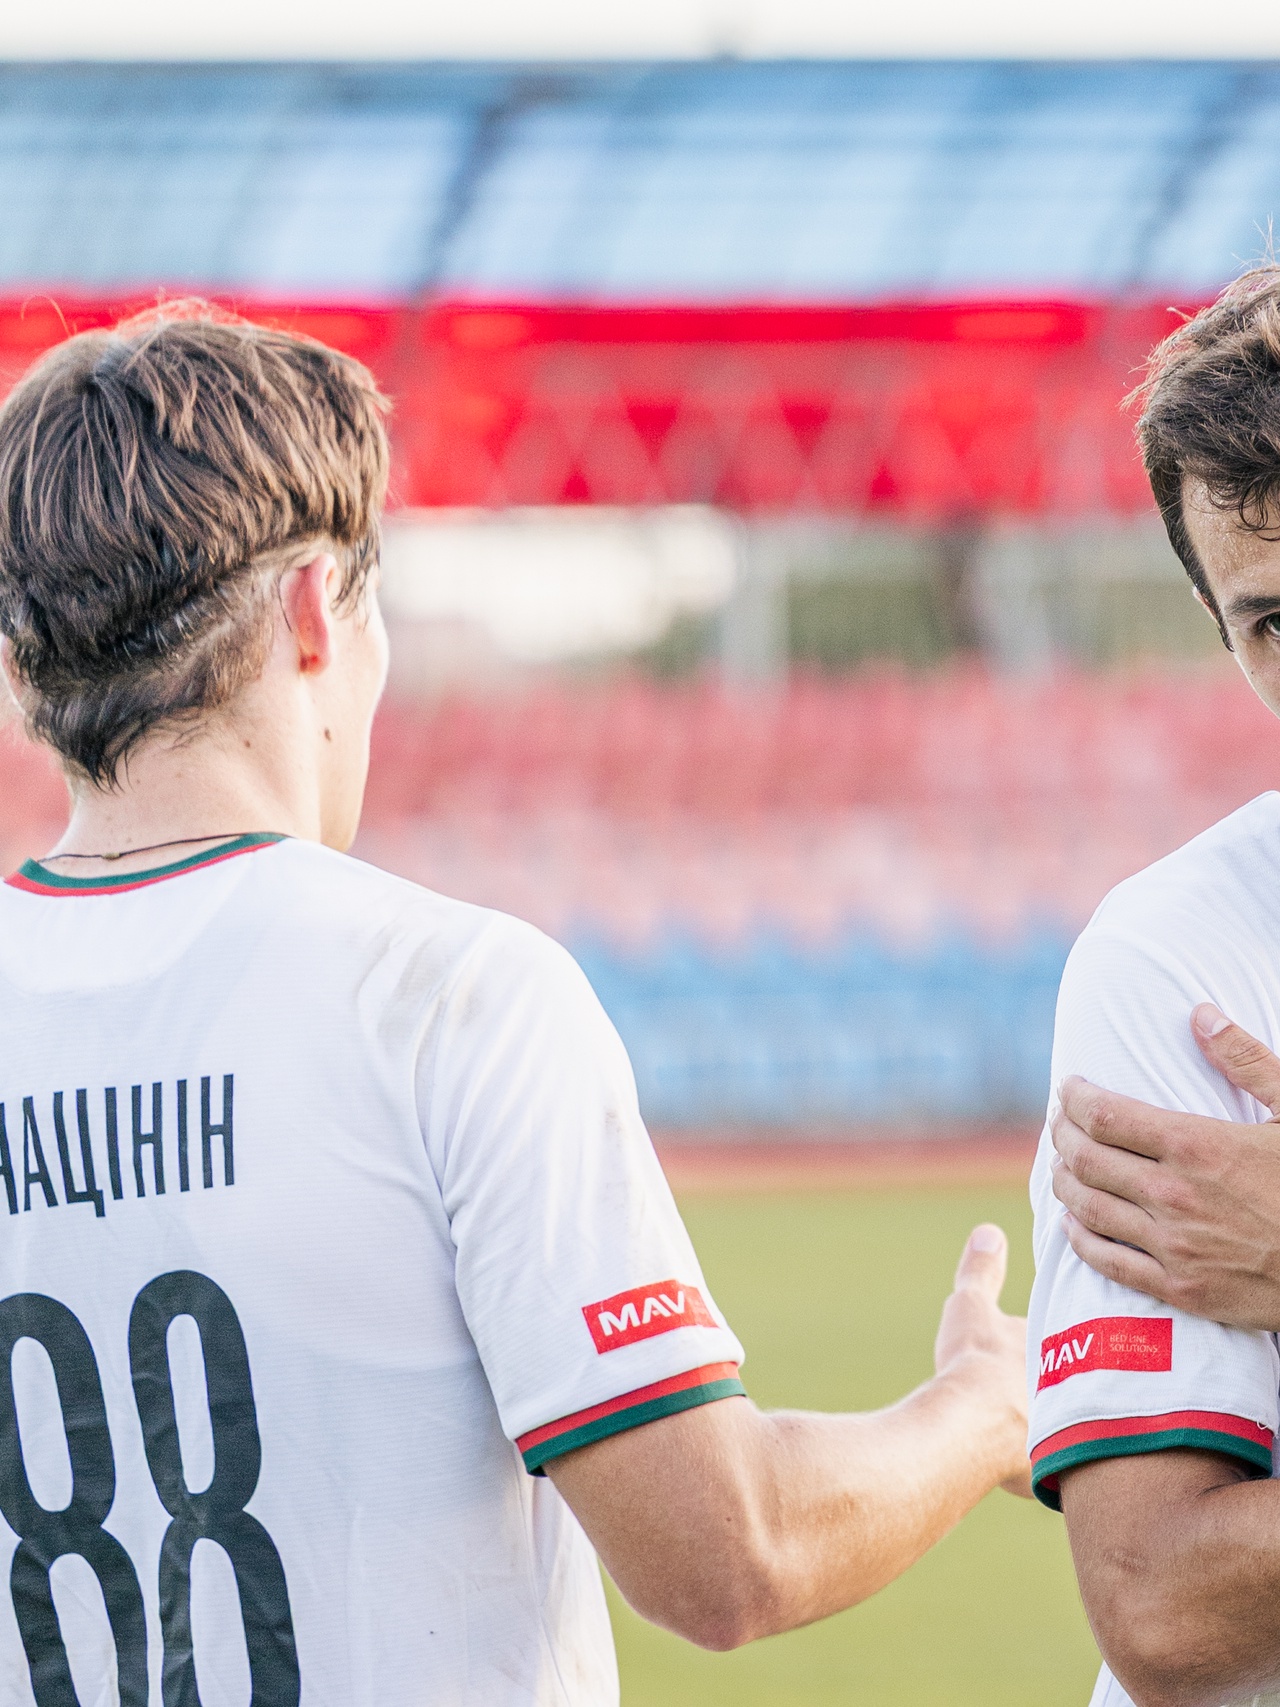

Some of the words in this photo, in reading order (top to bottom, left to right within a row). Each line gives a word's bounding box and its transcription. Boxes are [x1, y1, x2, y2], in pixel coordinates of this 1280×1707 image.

[598, 1291, 685, 1337] MAV
[1040, 1333, 1094, 1376] MAV
[1110, 1344, 1158, 1353] SOLUTIONS
[0, 1270, 301, 1707] 88
